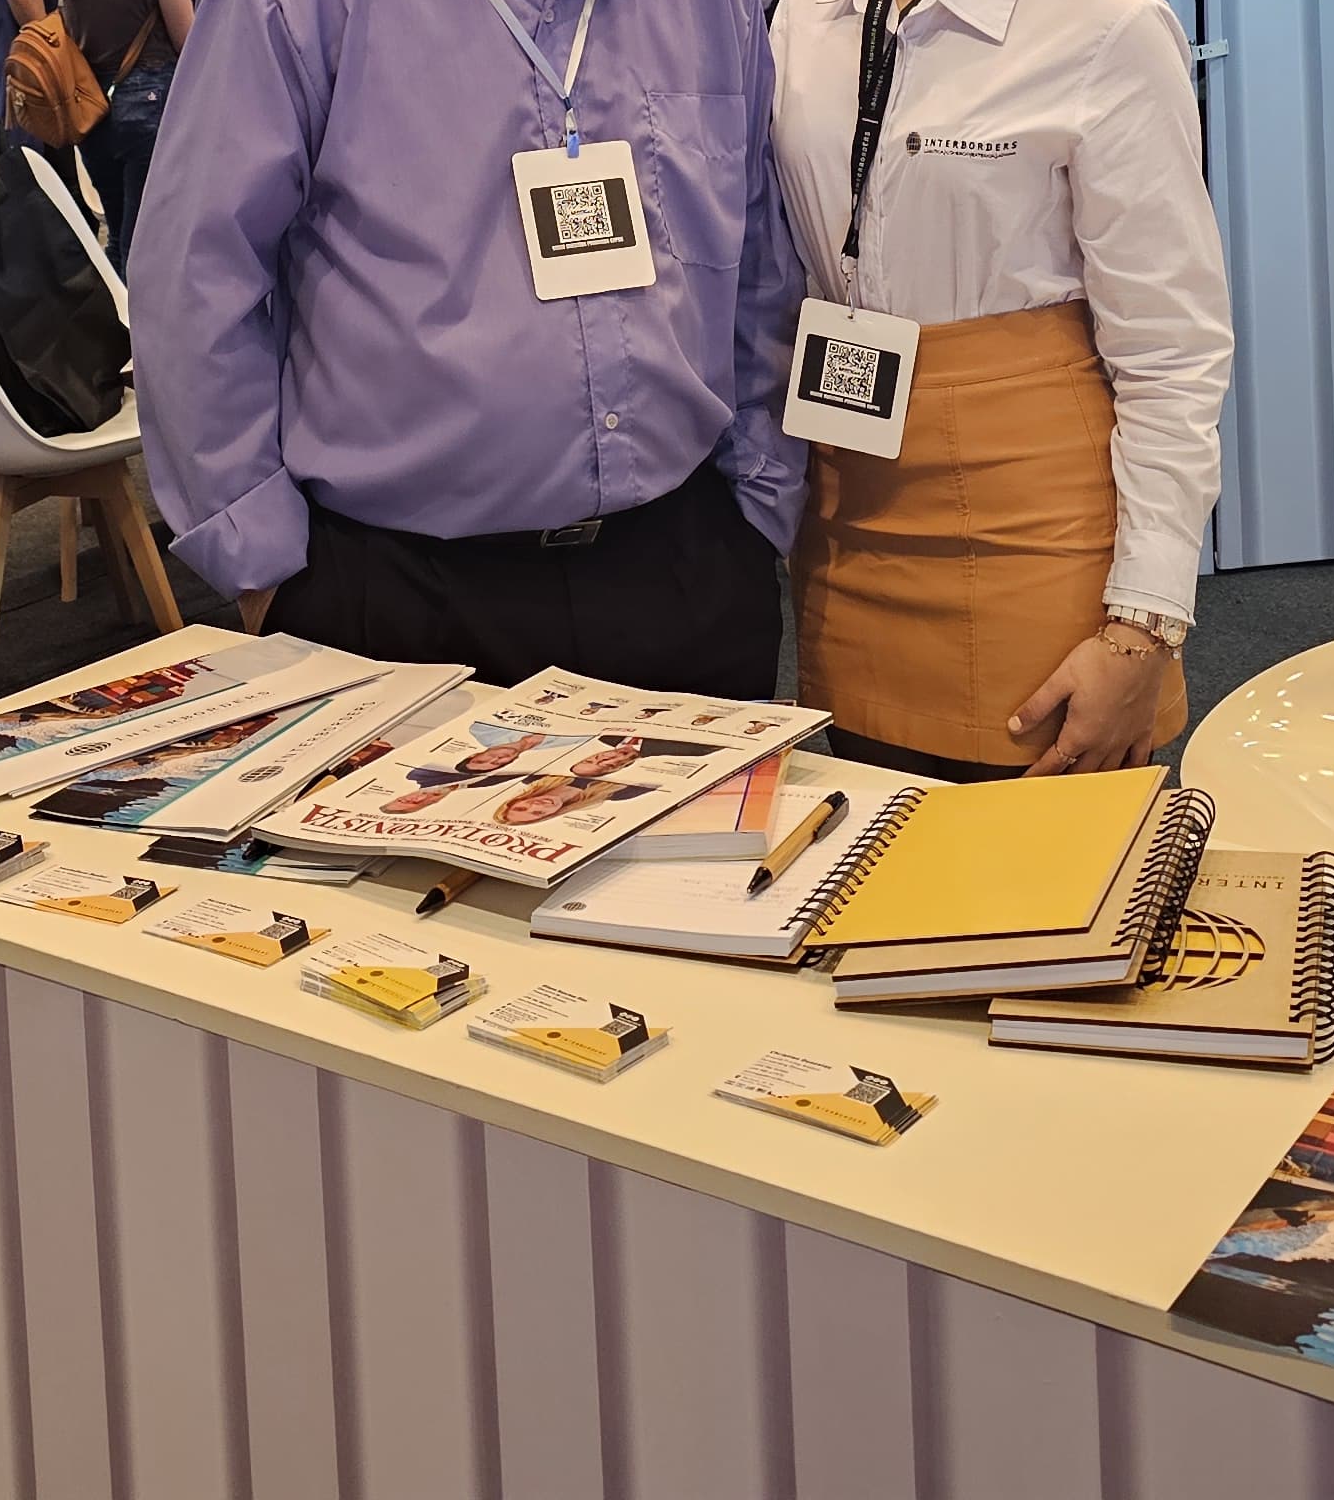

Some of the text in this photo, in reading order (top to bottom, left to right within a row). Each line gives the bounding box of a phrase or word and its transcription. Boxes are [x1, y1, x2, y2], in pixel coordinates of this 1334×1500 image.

[924, 139, 1017, 152] INTERBORDERS
[300, 803, 583, 864] PROTAGONISTA
[1197, 878, 1284, 890] INTER
